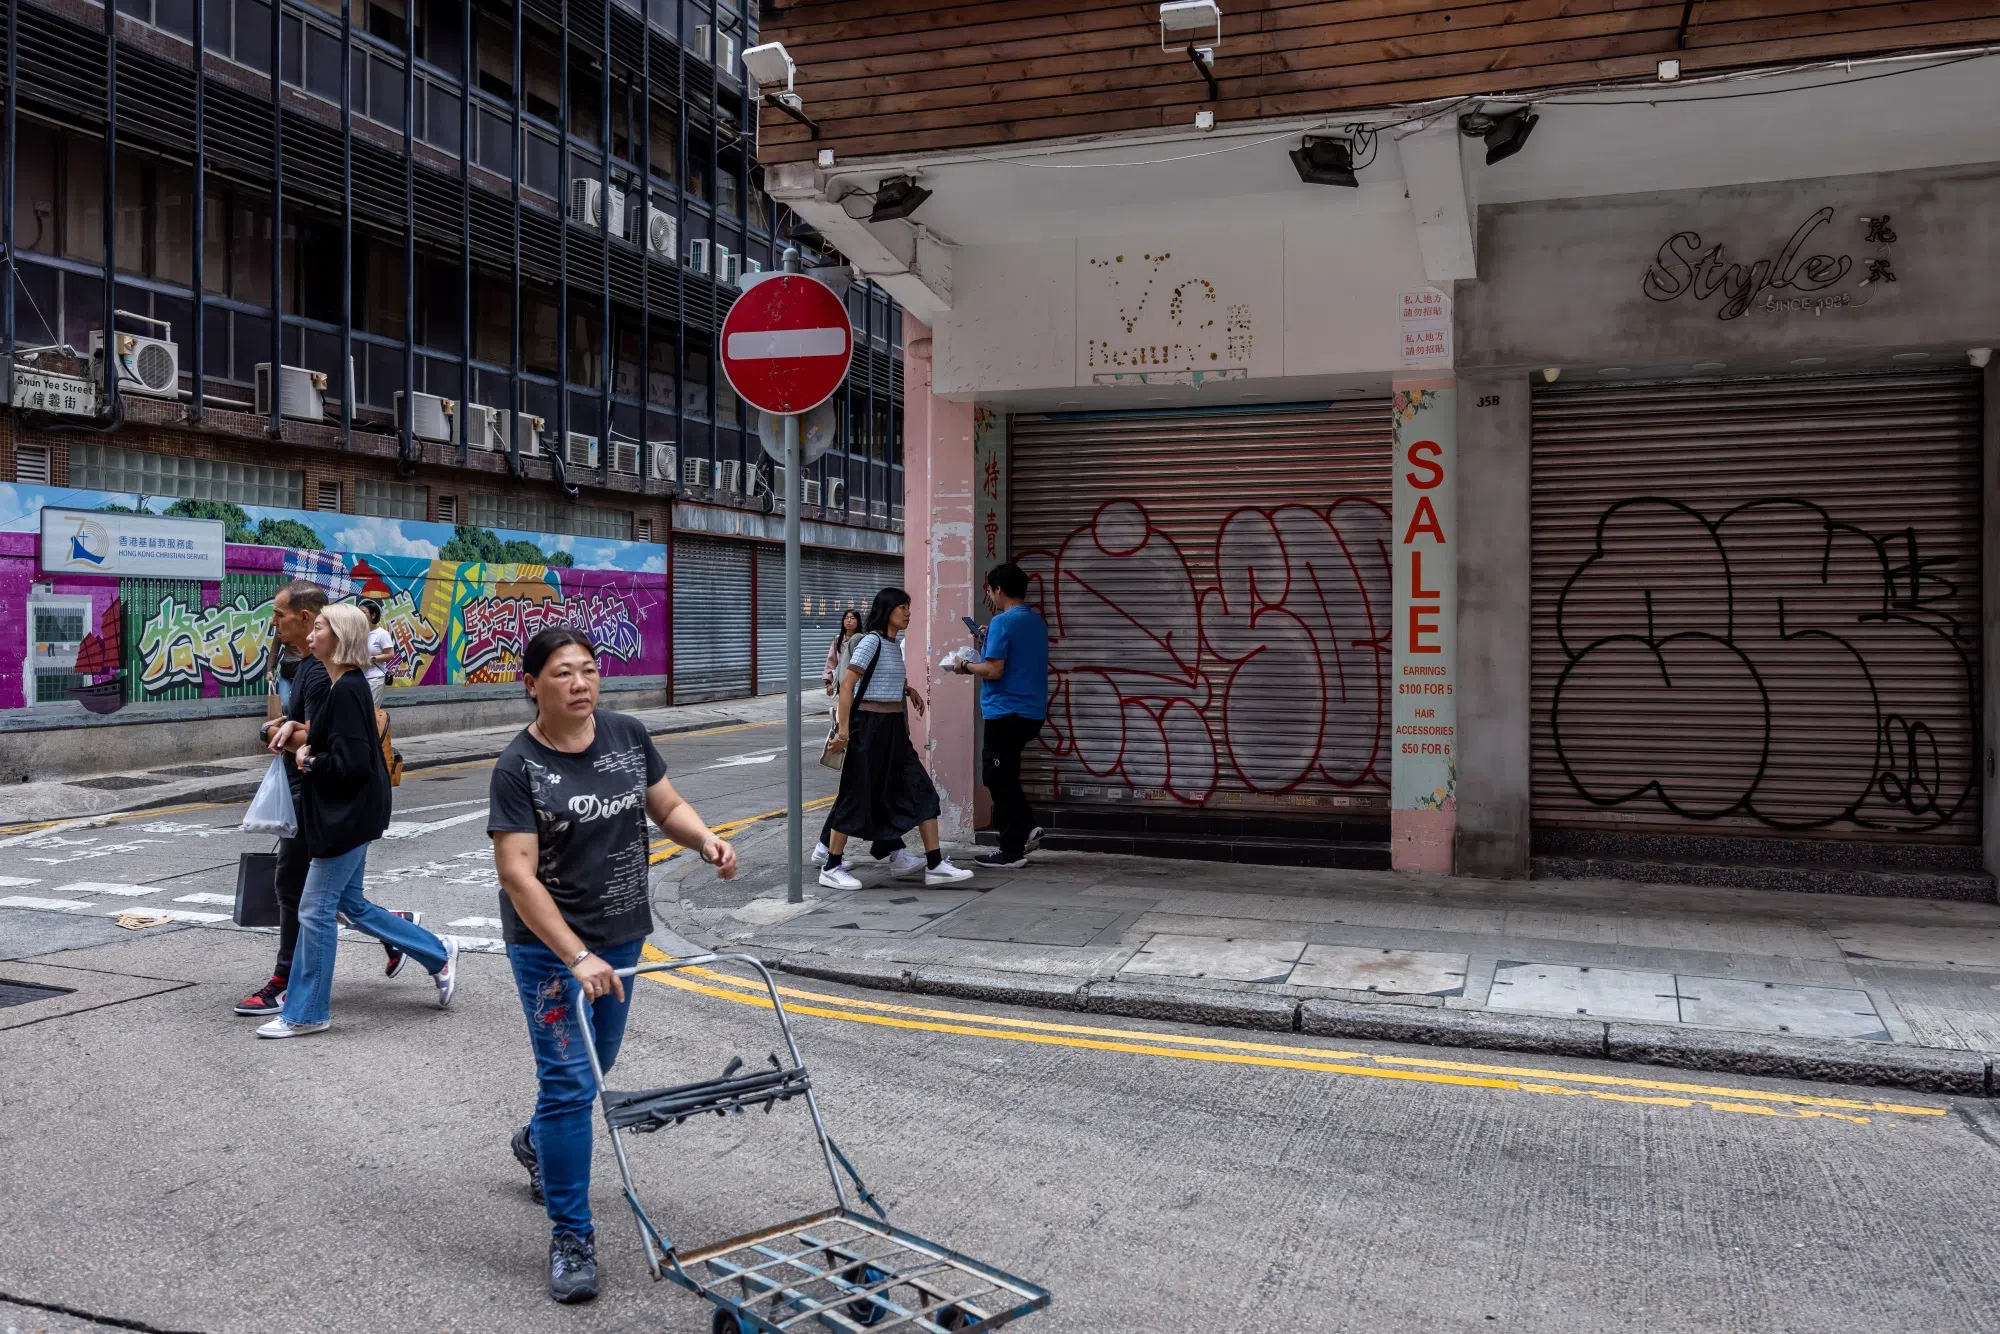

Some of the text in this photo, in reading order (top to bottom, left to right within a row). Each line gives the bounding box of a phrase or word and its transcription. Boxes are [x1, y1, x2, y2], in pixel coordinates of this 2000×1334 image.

[1644, 207, 1852, 320] Style
[1404, 294, 1442, 305] 私人地方
[1766, 297, 1811, 312] SINCE
[1405, 331, 1444, 344] 私人地方
[17, 375, 94, 395] Shun Yee Street
[1476, 395, 1500, 408] 35B
[118, 535, 194, 550] 香港基督教服務處
[1403, 440, 1447, 654] SALE
[118, 550, 137, 558] HONG
[155, 552, 186, 560] CHRISTIAN
[186, 553, 209, 561] SERVICE
[1403, 666, 1446, 676] EARRINGS
[1399, 684, 1453, 695] $100 FOR 5
[1414, 709, 1435, 719] HAIR
[1396, 725, 1454, 736] ACCESSORIES
[1401, 743, 1450, 755] $50 FOR 6
